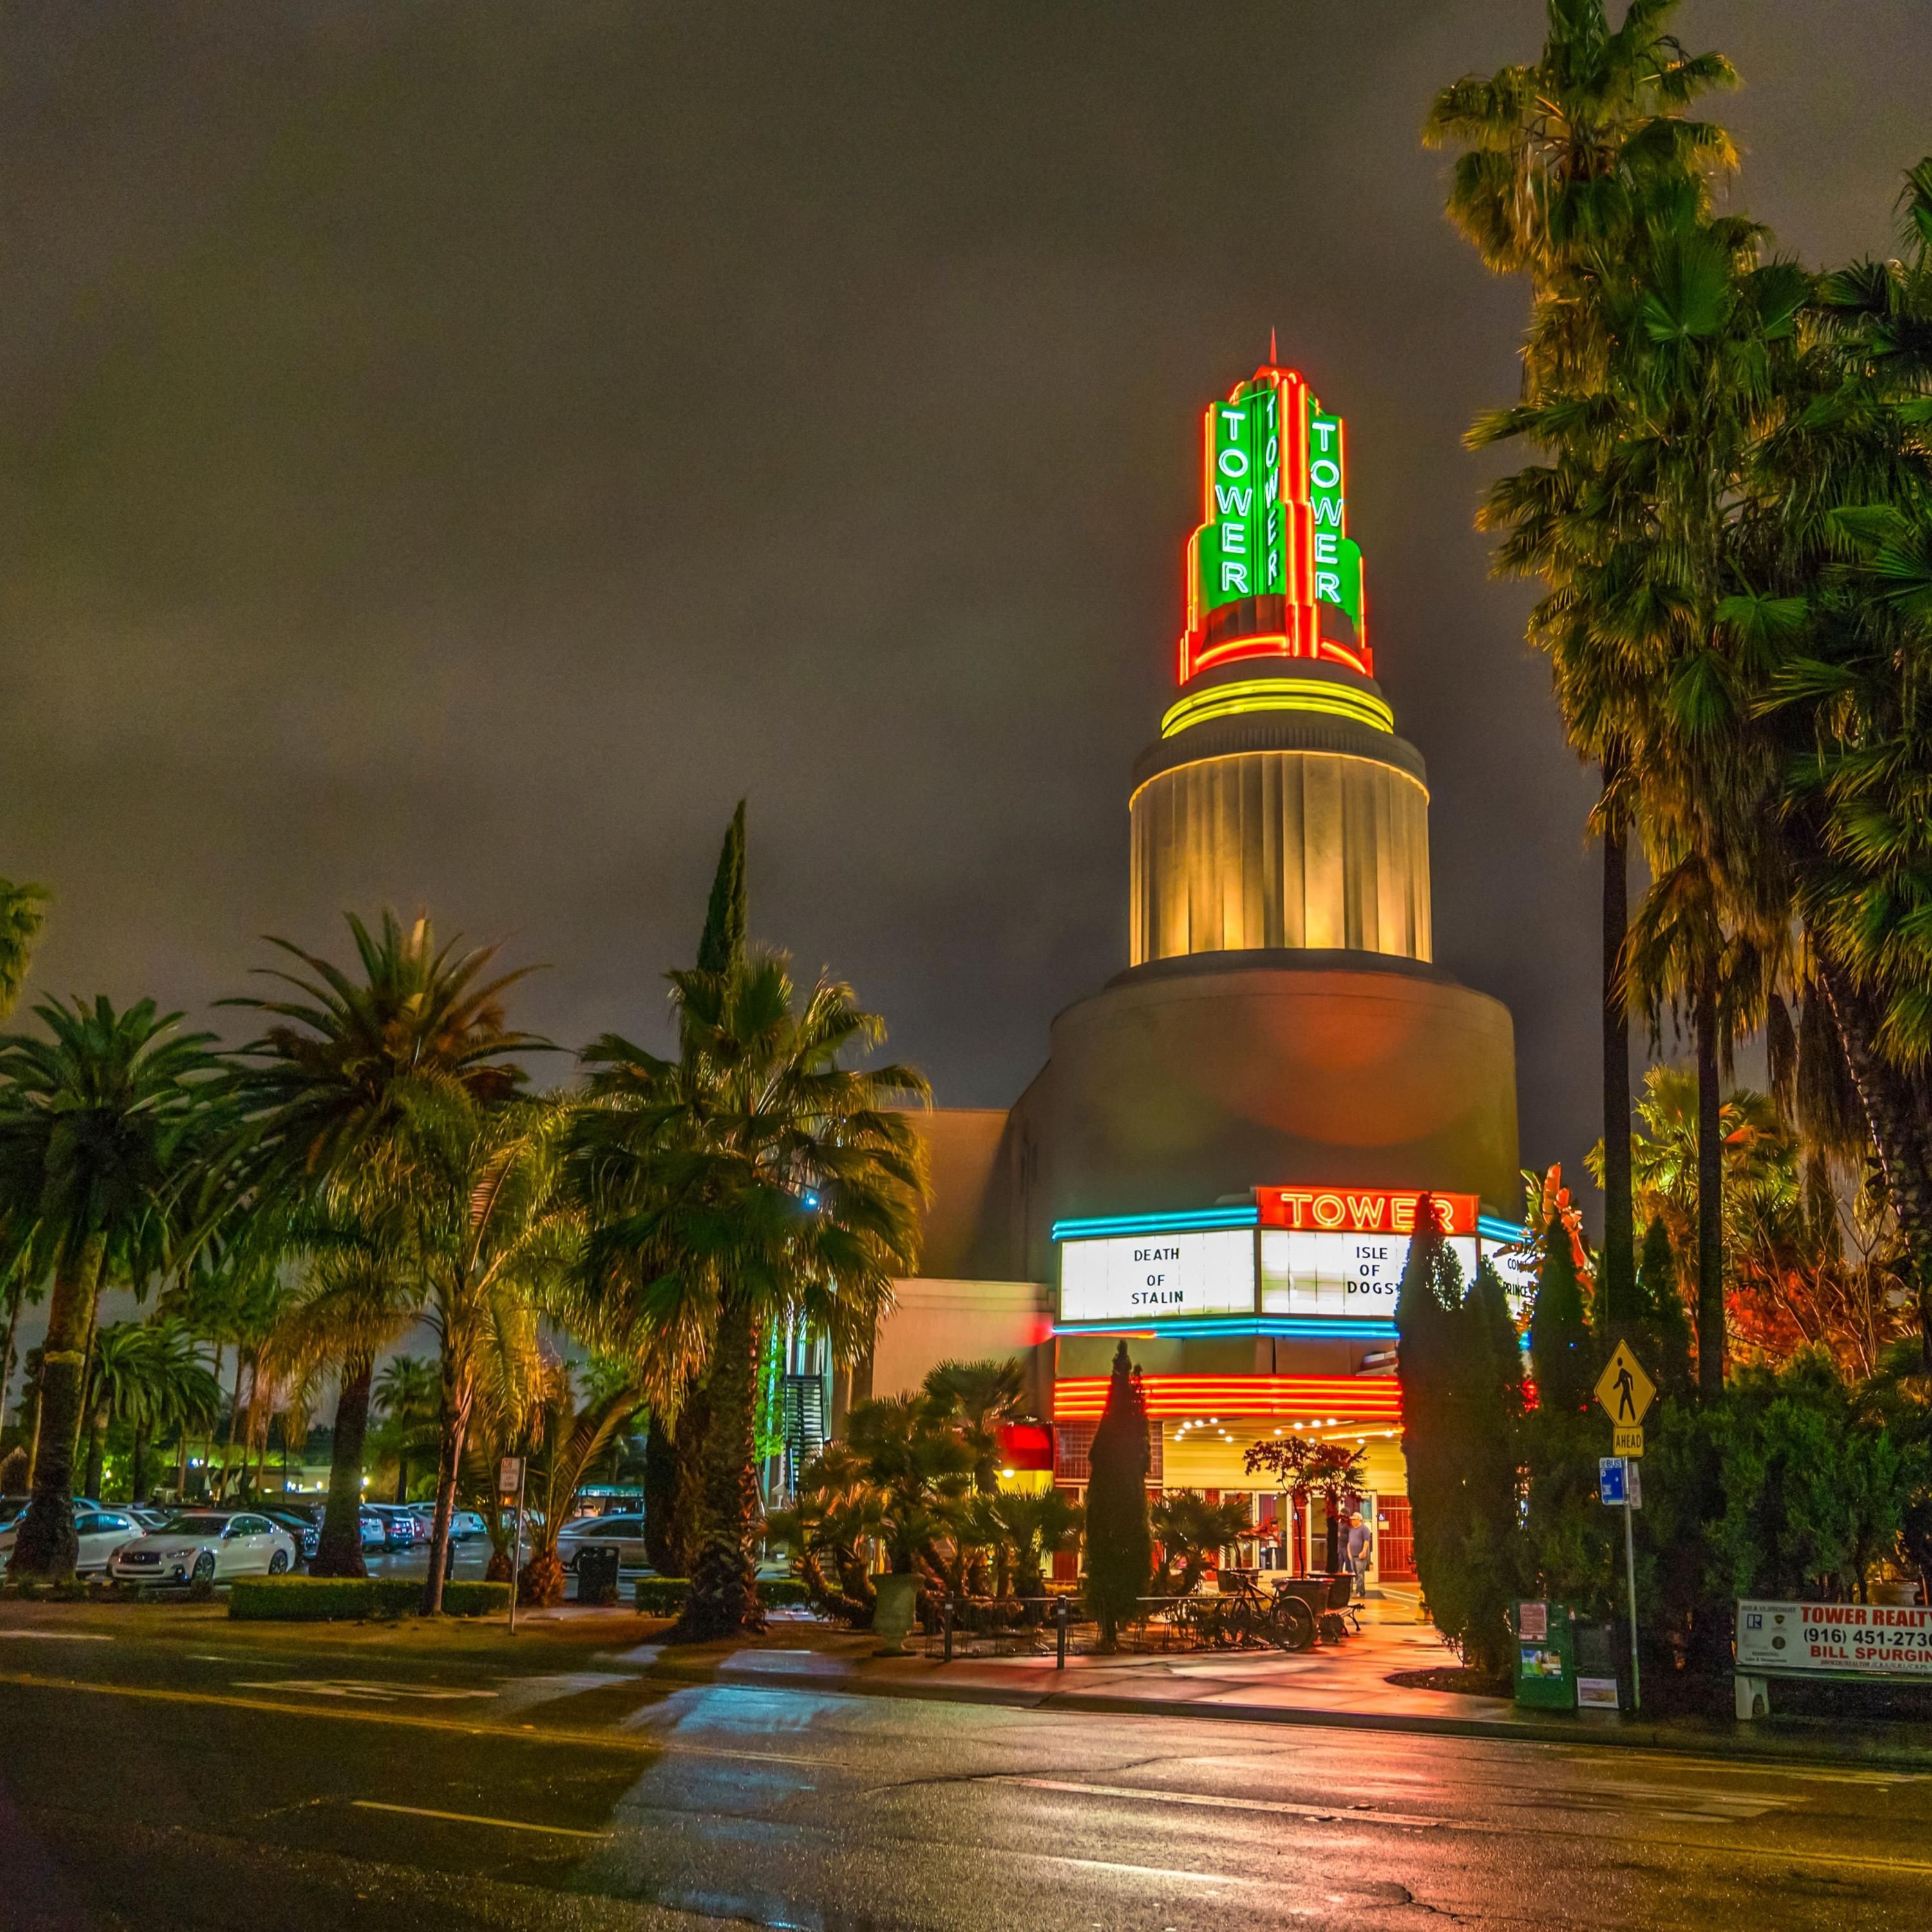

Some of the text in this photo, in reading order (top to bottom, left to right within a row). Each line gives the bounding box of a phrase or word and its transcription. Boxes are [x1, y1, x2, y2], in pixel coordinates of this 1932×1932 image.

[1265, 394, 1279, 585] TOWER
[1215, 410, 1252, 594] TOWER
[1310, 421, 1343, 603] TOWER
[1281, 1193, 1454, 1231] TOWER
[1134, 1247, 1179, 1262] DEATH
[1356, 1246, 1388, 1260] ISLE
[1359, 1264, 1380, 1276] OF
[1147, 1274, 1165, 1286] OF
[1347, 1281, 1394, 1294] DOGS
[1132, 1291, 1183, 1305] STALIN
[1616, 1434, 1642, 1448] AHEAD
[1607, 1459, 1621, 1468] BUS
[1801, 1607, 1866, 1625] TOWER
[1804, 1628, 1846, 1643] (916)
[1811, 1645, 1849, 1659] BILL
